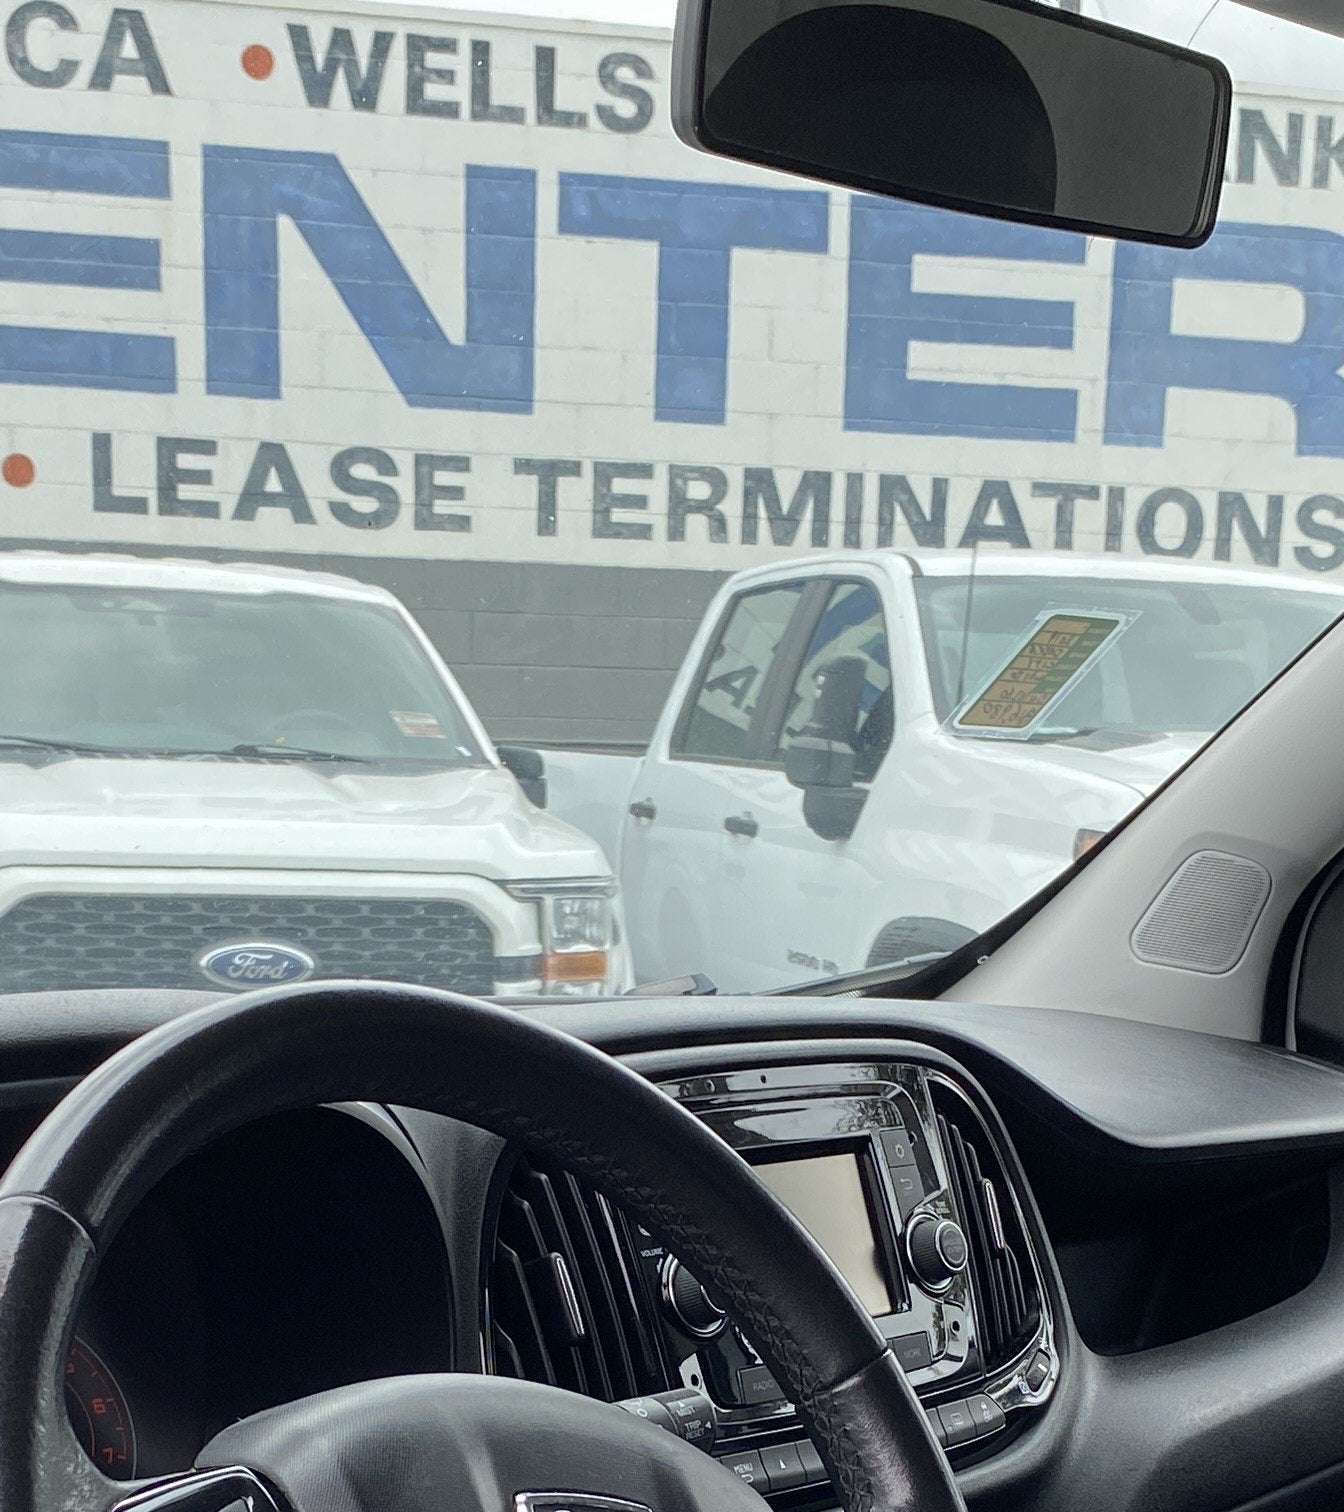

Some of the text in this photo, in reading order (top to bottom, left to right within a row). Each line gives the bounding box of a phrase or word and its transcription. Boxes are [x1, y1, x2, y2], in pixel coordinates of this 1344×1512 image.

[287, 23, 655, 134] WELLS
[92, 432, 472, 534] LEASE
[227, 952, 289, 979] Ford
